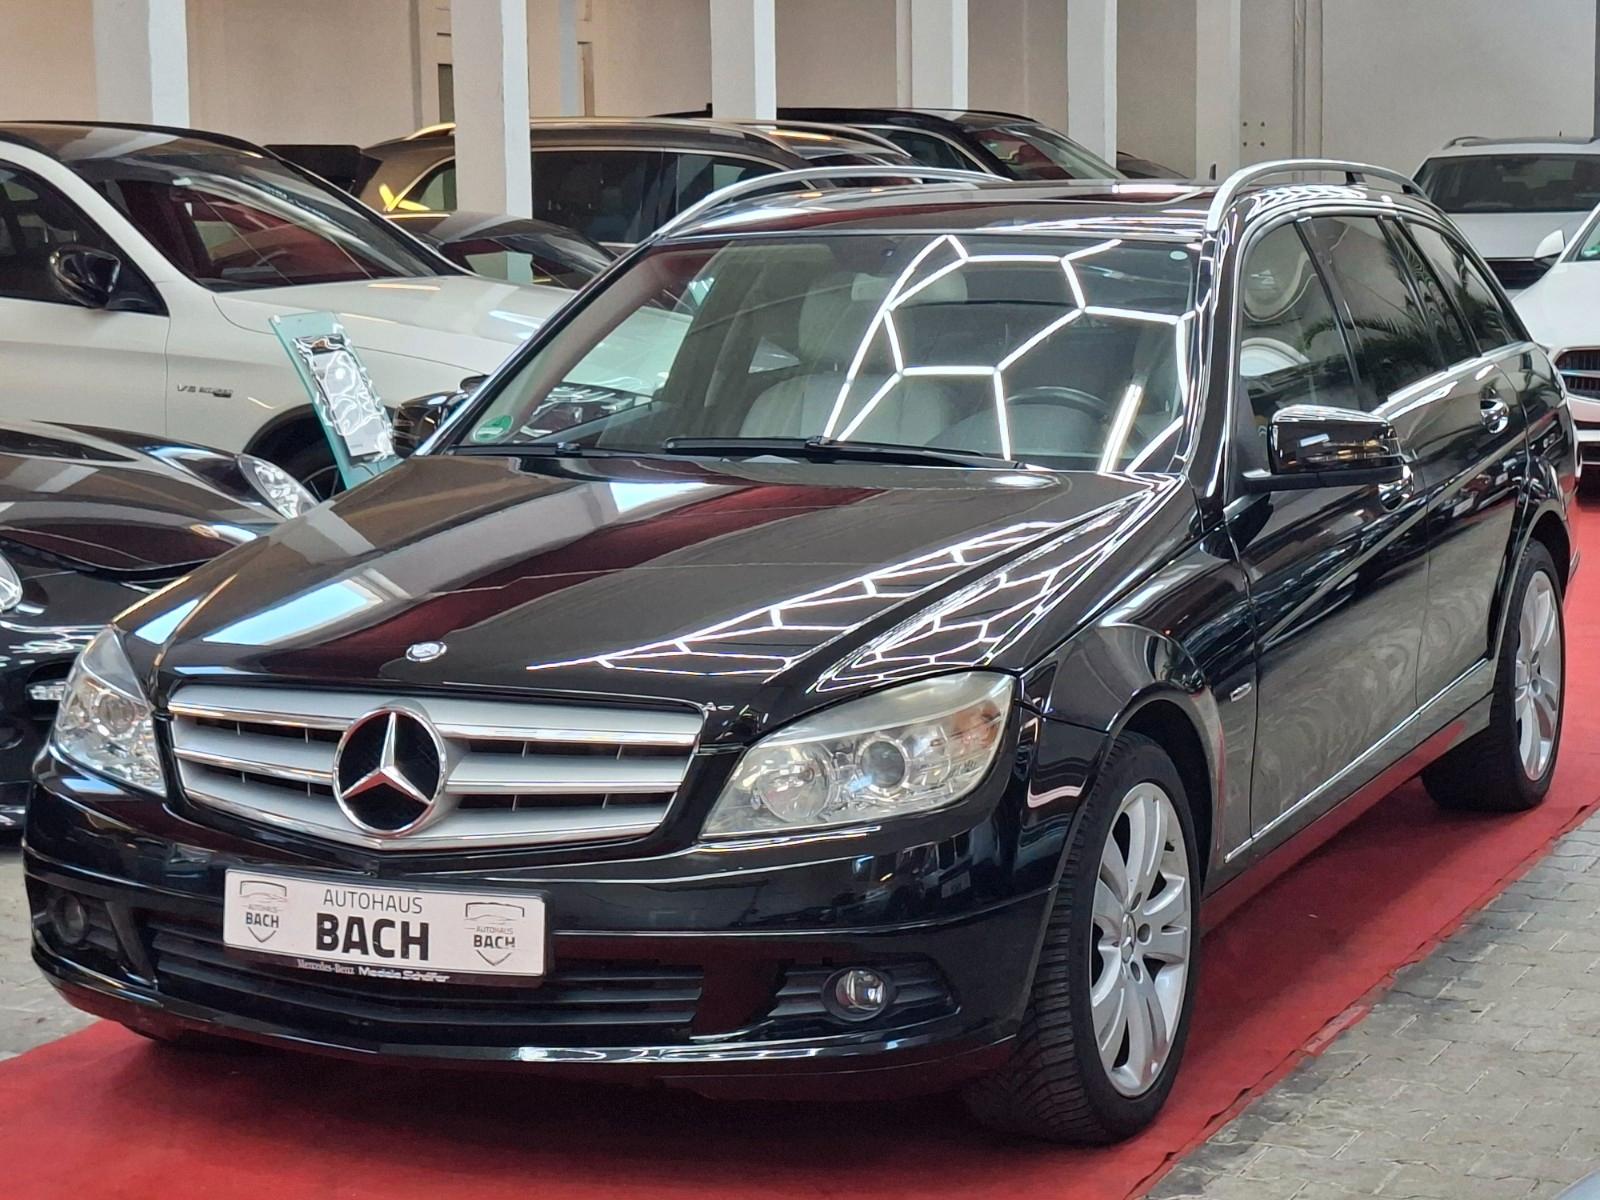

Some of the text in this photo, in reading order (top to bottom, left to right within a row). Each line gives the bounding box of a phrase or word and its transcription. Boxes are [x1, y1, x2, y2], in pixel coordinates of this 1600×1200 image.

[323, 888, 423, 914] AUTOHAUS
[245, 911, 279, 928] BACH
[316, 912, 430, 961] BACH
[473, 934, 516, 949] BACH
